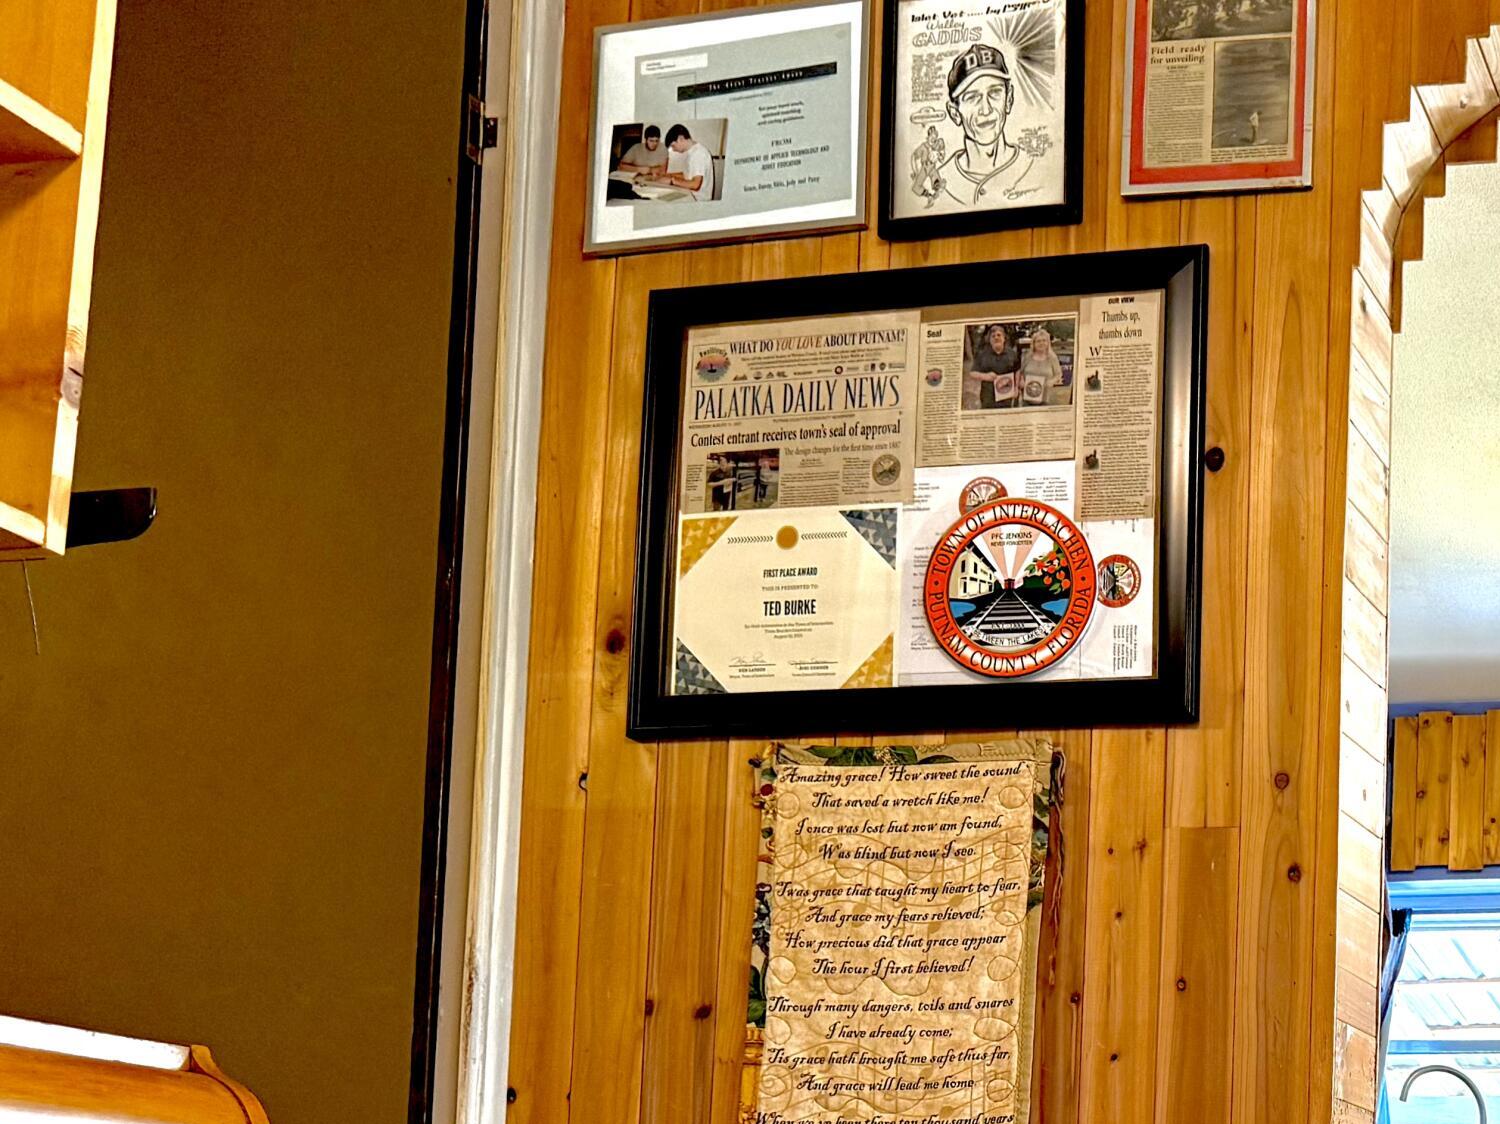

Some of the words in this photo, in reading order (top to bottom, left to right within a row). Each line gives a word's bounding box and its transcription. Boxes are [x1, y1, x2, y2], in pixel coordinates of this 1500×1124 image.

[912, 26, 983, 48] GADDIS
[1150, 56, 1164, 65] for
[1165, 54, 1205, 64] unveiling
[1151, 46, 1174, 55] Field
[1180, 44, 1206, 54] ready
[1102, 310, 1128, 323] Thumbs
[729, 341, 757, 356] WHAT
[758, 339, 774, 352] DO
[775, 338, 799, 351] YOU
[798, 336, 822, 350] LOVE
[823, 333, 858, 348] ABOUT
[858, 328, 906, 345] PUTNAM?
[1098, 327, 1122, 340] thumbs
[1124, 325, 1142, 338] down
[694, 383, 775, 421] PALATKA
[782, 378, 838, 414] DAILY
[844, 374, 901, 410] NEWS
[691, 431, 725, 448] Contest
[727, 430, 761, 446] entrant
[762, 427, 797, 443] receives
[799, 423, 827, 440] town's
[829, 422, 847, 438] seal
[848, 420, 860, 437] of
[860, 418, 901, 442] approval
[934, 530, 967, 576] TOWN
[965, 509, 988, 533] OF
[992, 503, 1090, 572] INTERLACHEN
[1005, 531, 1033, 540] JENKINS
[763, 568, 778, 579] FIRST
[779, 567, 797, 578] PLACE
[797, 566, 818, 577] AWARD
[763, 600, 781, 616] TED
[784, 598, 817, 616] BURKE
[929, 591, 970, 659] PUTNAM
[970, 649, 1045, 674] COUNTY,
[1047, 586, 1092, 657] FLORIDA
[780, 766, 841, 788] Amazing
[840, 766, 886, 788] grace!
[887, 763, 921, 783] How
[923, 768, 957, 781] sweet
[960, 763, 980, 779] the
[982, 761, 1021, 777] sound
[811, 791, 842, 808] That
[844, 793, 883, 807] saved
[882, 799, 890, 807] a
[892, 791, 934, 808] wretch
[936, 790, 960, 806] like
[962, 786, 990, 805] me!
[795, 817, 809, 836] I
[806, 824, 834, 834] once
[836, 824, 860, 834] was
[861, 818, 884, 834] lost
[887, 820, 909, 833] but
[911, 822, 938, 833] now
[939, 821, 957, 832] am
[819, 840, 852, 861] Was
[853, 842, 887, 860] blind
[889, 845, 911, 860] but
[914, 848, 940, 859] now
[941, 839, 956, 859] I
[808, 887, 844, 903] grace
[846, 883, 872, 897] that
[874, 882, 918, 902] taught
[920, 885, 939, 903] my
[941, 881, 974, 895] heart
[976, 883, 990, 893] to
[805, 905, 841, 923] And
[835, 914, 872, 928] grace
[874, 913, 895, 930] my
[892, 907, 930, 929] fears
[931, 905, 985, 920] relieved;
[785, 928, 816, 949] How
[813, 936, 870, 954] precious
[872, 934, 898, 949] did
[897, 934, 923, 949] that
[921, 937, 959, 953] grace
[961, 934, 1007, 952] appear
[812, 957, 837, 975] The
[839, 958, 869, 975] hour
[871, 956, 886, 977] I
[878, 959, 914, 981] first
[916, 954, 975, 974] believed!
[768, 995, 822, 1019] Through
[825, 1001, 858, 1018] many
[861, 997, 913, 1018] dangers,
[917, 996, 945, 1011] toils
[948, 996, 976, 1011] and
[975, 998, 1014, 1010] snares
[826, 1022, 841, 1040] I
[840, 1023, 866, 1038] have
[869, 1021, 916, 1045] already
[919, 1027, 954, 1038] come;
[788, 1055, 826, 1070] grace
[828, 1050, 860, 1065] hath
[858, 1050, 907, 1071] brought
[910, 1053, 927, 1064] me
[930, 1048, 956, 1069] safe
[957, 1047, 987, 1063] thus
[796, 1071, 834, 1091] And
[829, 1081, 866, 1097] grace
[868, 1076, 896, 1091] will
[895, 1076, 924, 1091] lead
[923, 1080, 940, 1090] me
